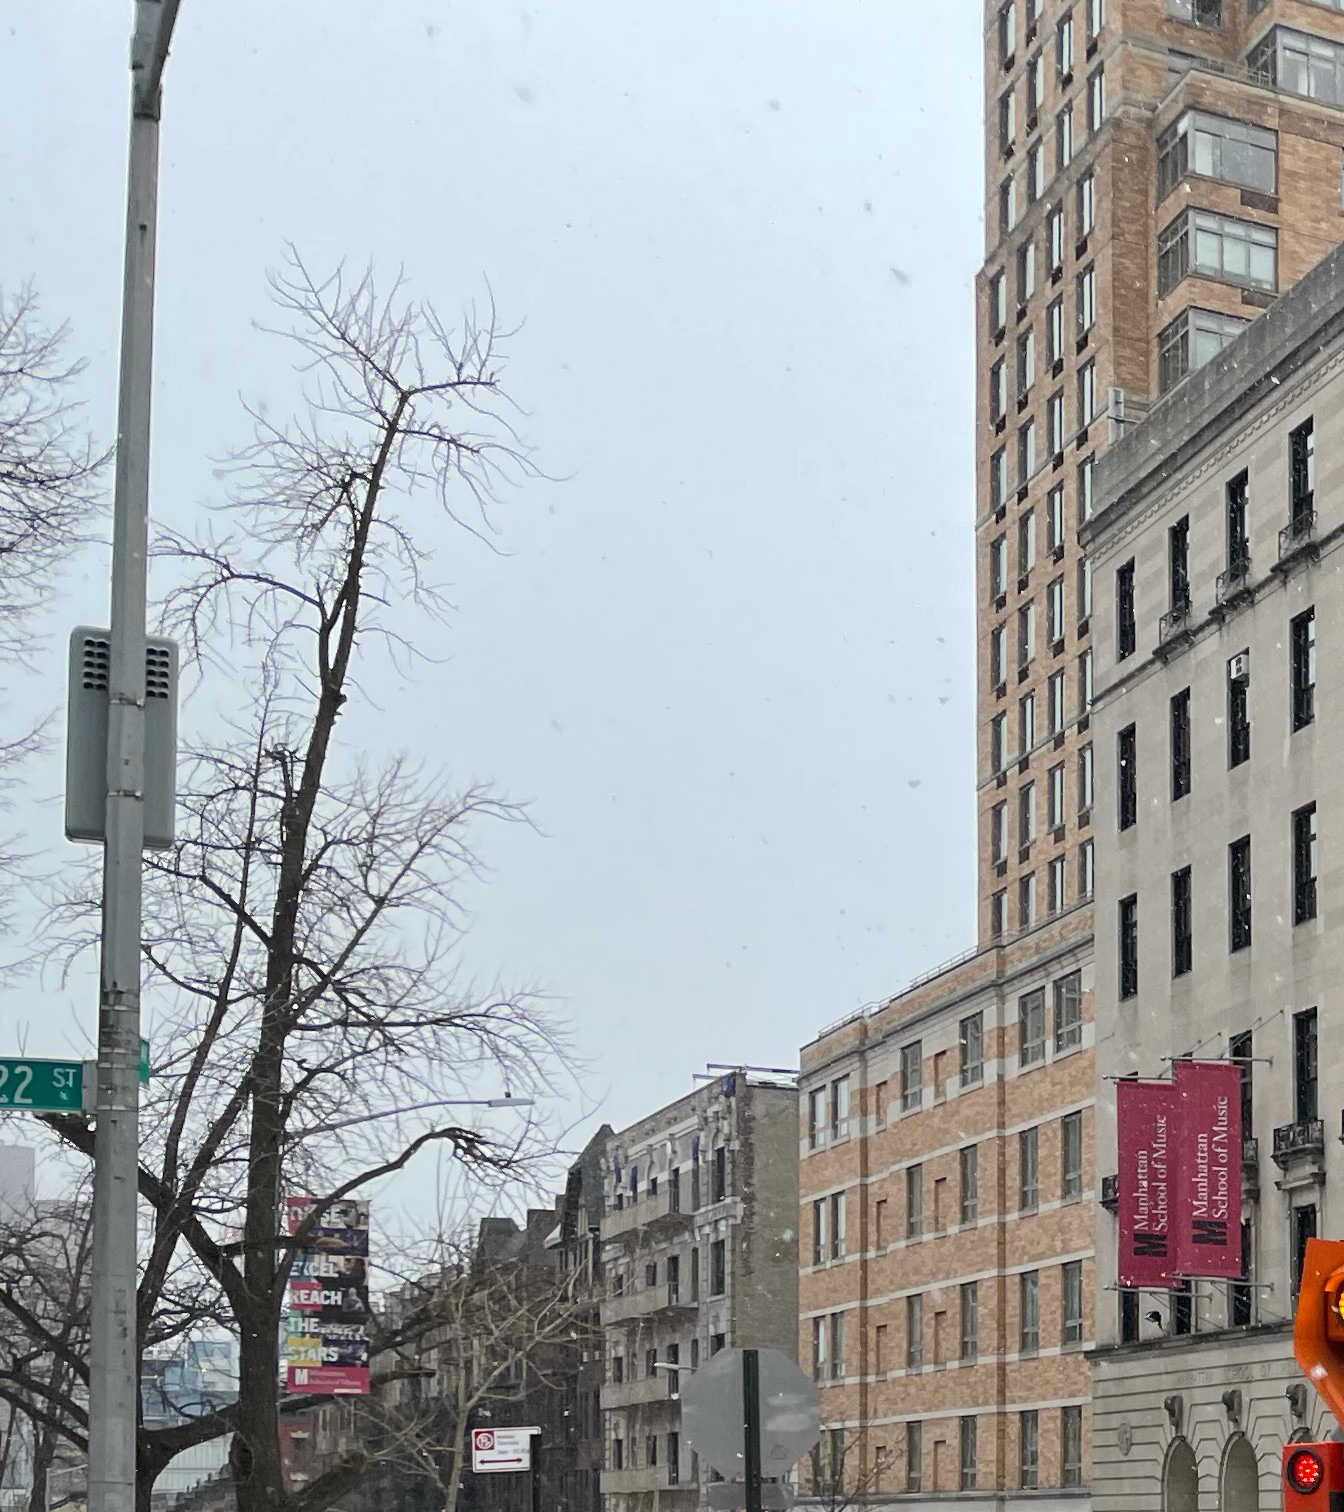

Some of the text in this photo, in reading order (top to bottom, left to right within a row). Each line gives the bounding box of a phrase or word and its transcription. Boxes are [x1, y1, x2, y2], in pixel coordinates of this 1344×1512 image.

[52, 1067, 77, 1088] ST
[1212, 1096, 1228, 1219] School of Music
[1152, 1115, 1168, 1232] School of Music
[1191, 1133, 1209, 1217] Manhattan
[1133, 1150, 1149, 1230] Manhattan
[1133, 1233, 1168, 1258] M
[1192, 1220, 1228, 1246] M
[289, 1260, 340, 1278] EXCEL
[290, 1290, 342, 1306] REACH
[288, 1317, 320, 1333] THE
[288, 1346, 339, 1363] STARS
